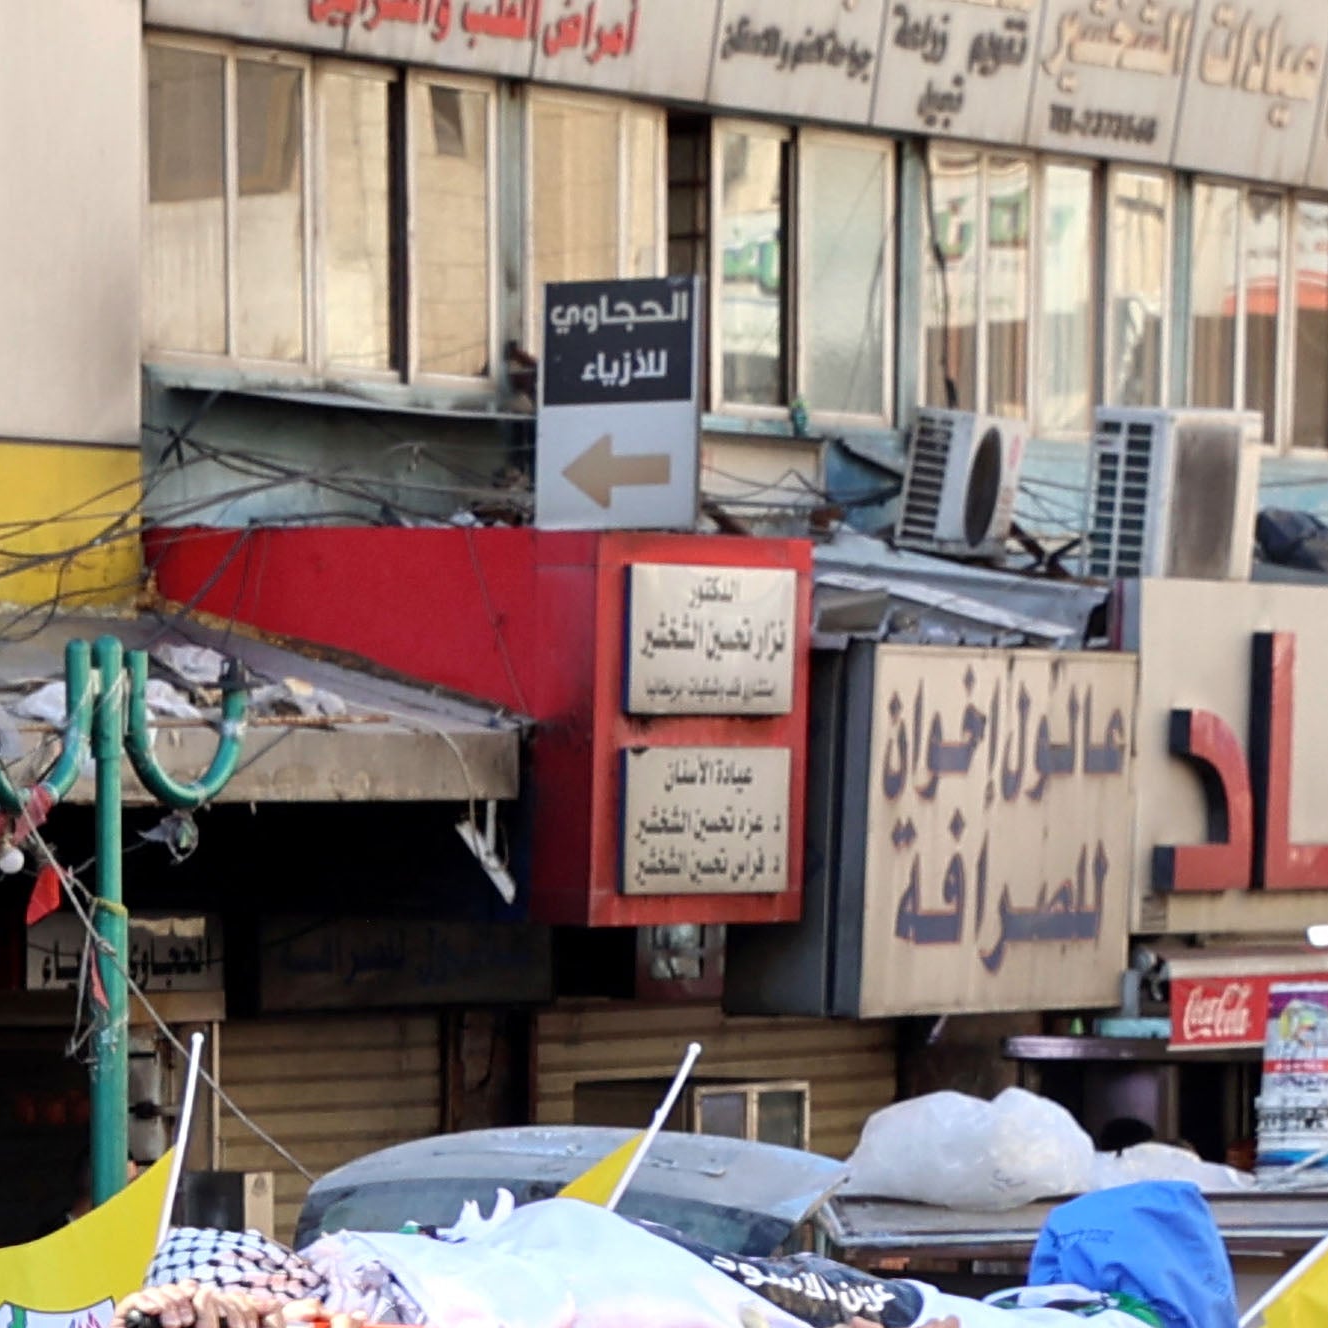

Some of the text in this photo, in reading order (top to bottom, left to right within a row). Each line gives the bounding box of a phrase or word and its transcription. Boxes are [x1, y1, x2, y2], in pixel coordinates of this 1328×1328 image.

[1198, 3, 1319, 129] عيادات
[550, 291, 689, 334] الحجاوي
[580, 349, 669, 383] للأزياء
[664, 754, 753, 794] عيادة الأسنان
[891, 812, 1111, 974] للصرافة
[838, 1280, 897, 1315] عرين
